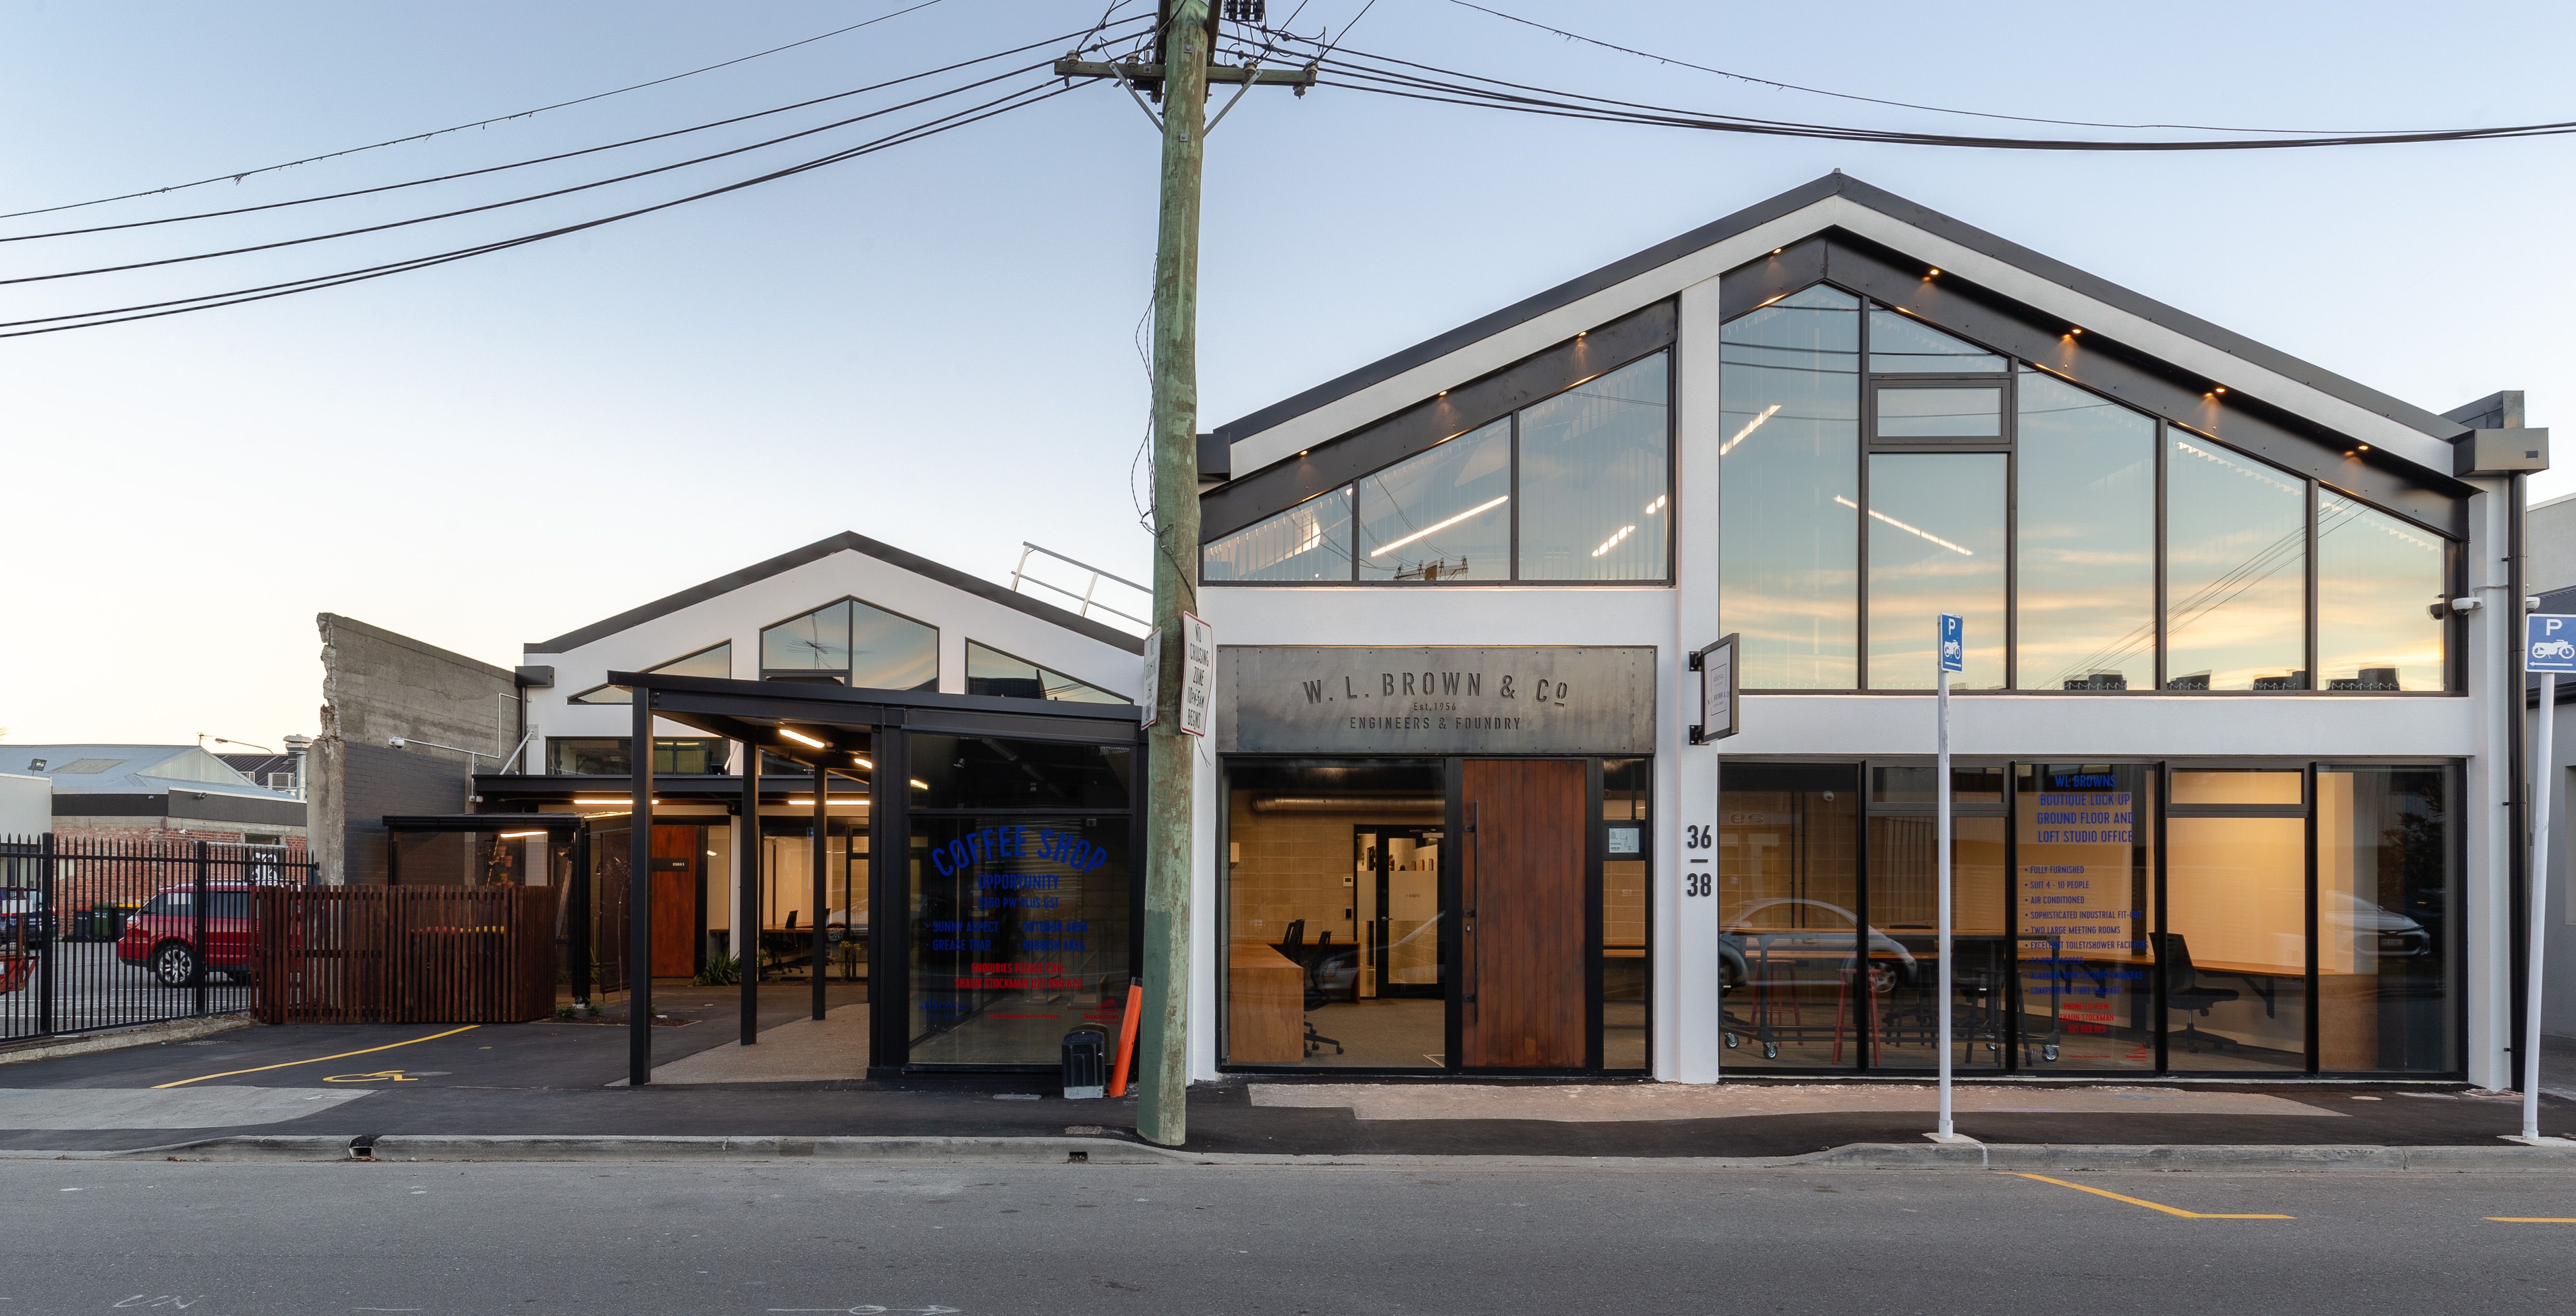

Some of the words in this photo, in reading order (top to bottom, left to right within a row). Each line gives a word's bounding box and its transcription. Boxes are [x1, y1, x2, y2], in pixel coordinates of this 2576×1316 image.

[1949, 618, 1955, 635] P
[2546, 619, 2563, 635] P
[1195, 626, 1201, 642] NO
[1190, 643, 1209, 667] CRUISING
[1193, 667, 1204, 686] ZONE
[1303, 680, 1333, 705] W.
[1346, 676, 1369, 700] L.
[1382, 672, 1480, 697] BROWN
[1500, 675, 1515, 699] &
[1188, 709, 1201, 729] BEGINS
[1350, 717, 1430, 730] ENGINEERS
[1438, 717, 1446, 730] &
[1456, 717, 1521, 730] FOUNDRY
[2055, 775, 2070, 787] WL
[2073, 775, 2116, 787] BROWNS
[2040, 794, 2086, 806] BOUTIQUE
[2090, 794, 2114, 805] LOCK
[2118, 794, 2130, 805] UP
[2037, 812, 2076, 824] GROUND
[2080, 812, 2110, 824] FLOOR
[2114, 812, 2134, 824] AND
[1687, 825, 1712, 849] 36
[2038, 830, 2060, 842] LOFT
[2063, 830, 2097, 842] STUDIO
[2101, 830, 2133, 842] OFFICE
[931, 826, 1027, 876] COFFEE
[1037, 828, 1107, 874] SHOP
[978, 874, 1059, 890] OPPORTUNITY
[1687, 873, 1712, 897] 38
[1003, 897, 1017, 908] PW
[1020, 897, 1040, 908] PLUS
[1044, 897, 1059, 908] GST
[933, 920, 963, 932] SUNNY
[966, 920, 999, 932] ASPECT
[1066, 920, 1088, 933] AREA
[933, 939, 966, 950] GREASE
[969, 939, 991, 950] TRAP
[1063, 939, 1086, 951] AREA
[971, 962, 1012, 974] ENQUIRIES
[1015, 962, 1043, 974] PLEASE
[1046, 962, 1065, 974] CALL
[955, 978, 982, 989] SHAUN
[984, 978, 1028, 989] STOCKMAN
[1031, 978, 1045, 989] 021
